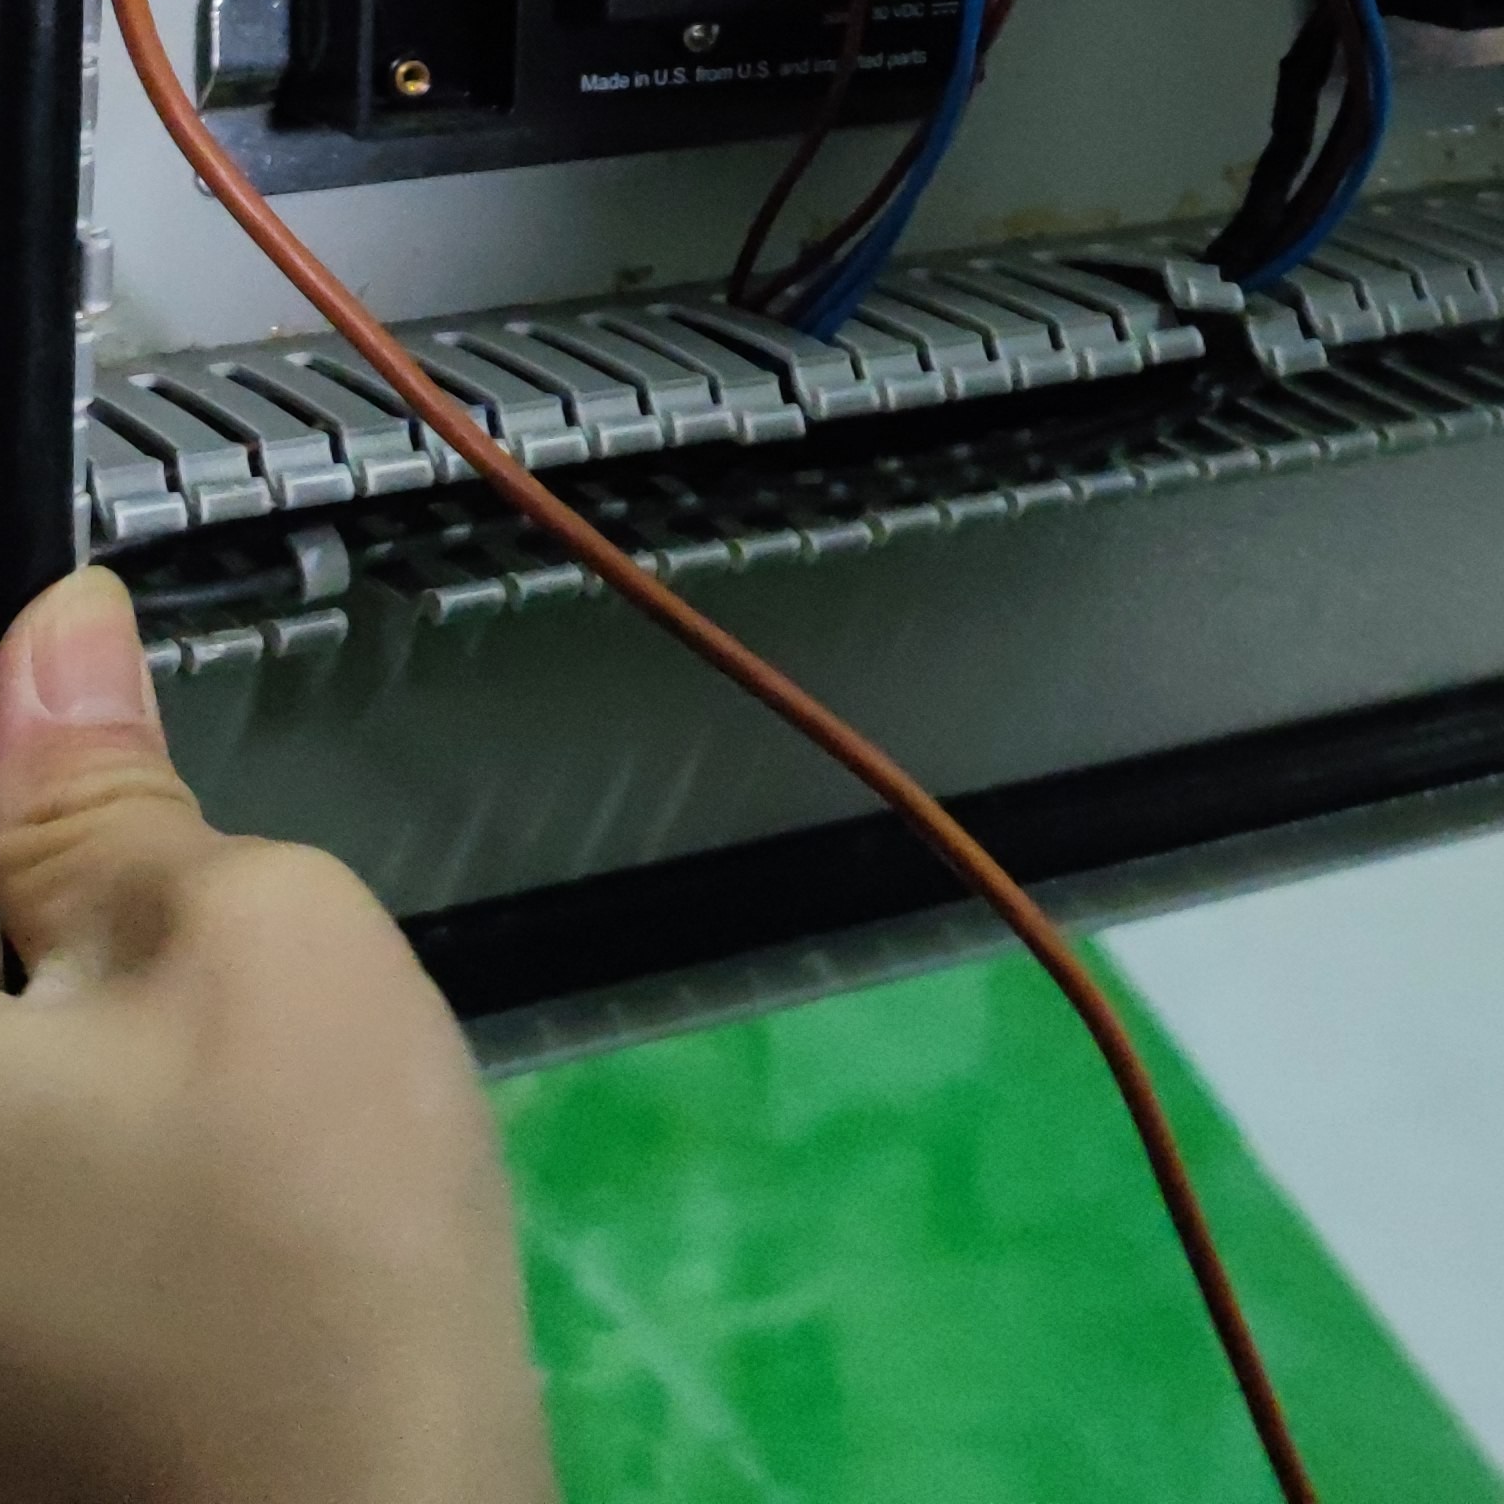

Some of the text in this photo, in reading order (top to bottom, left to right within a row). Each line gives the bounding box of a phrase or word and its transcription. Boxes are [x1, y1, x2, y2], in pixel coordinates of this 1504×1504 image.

[580, 71, 630, 94] Made
[633, 70, 650, 90] in
[654, 66, 689, 88] U.S.
[696, 64, 732, 85] from
[736, 60, 771, 81] U.S.
[779, 58, 810, 78] and
[886, 49, 928, 72] parts
